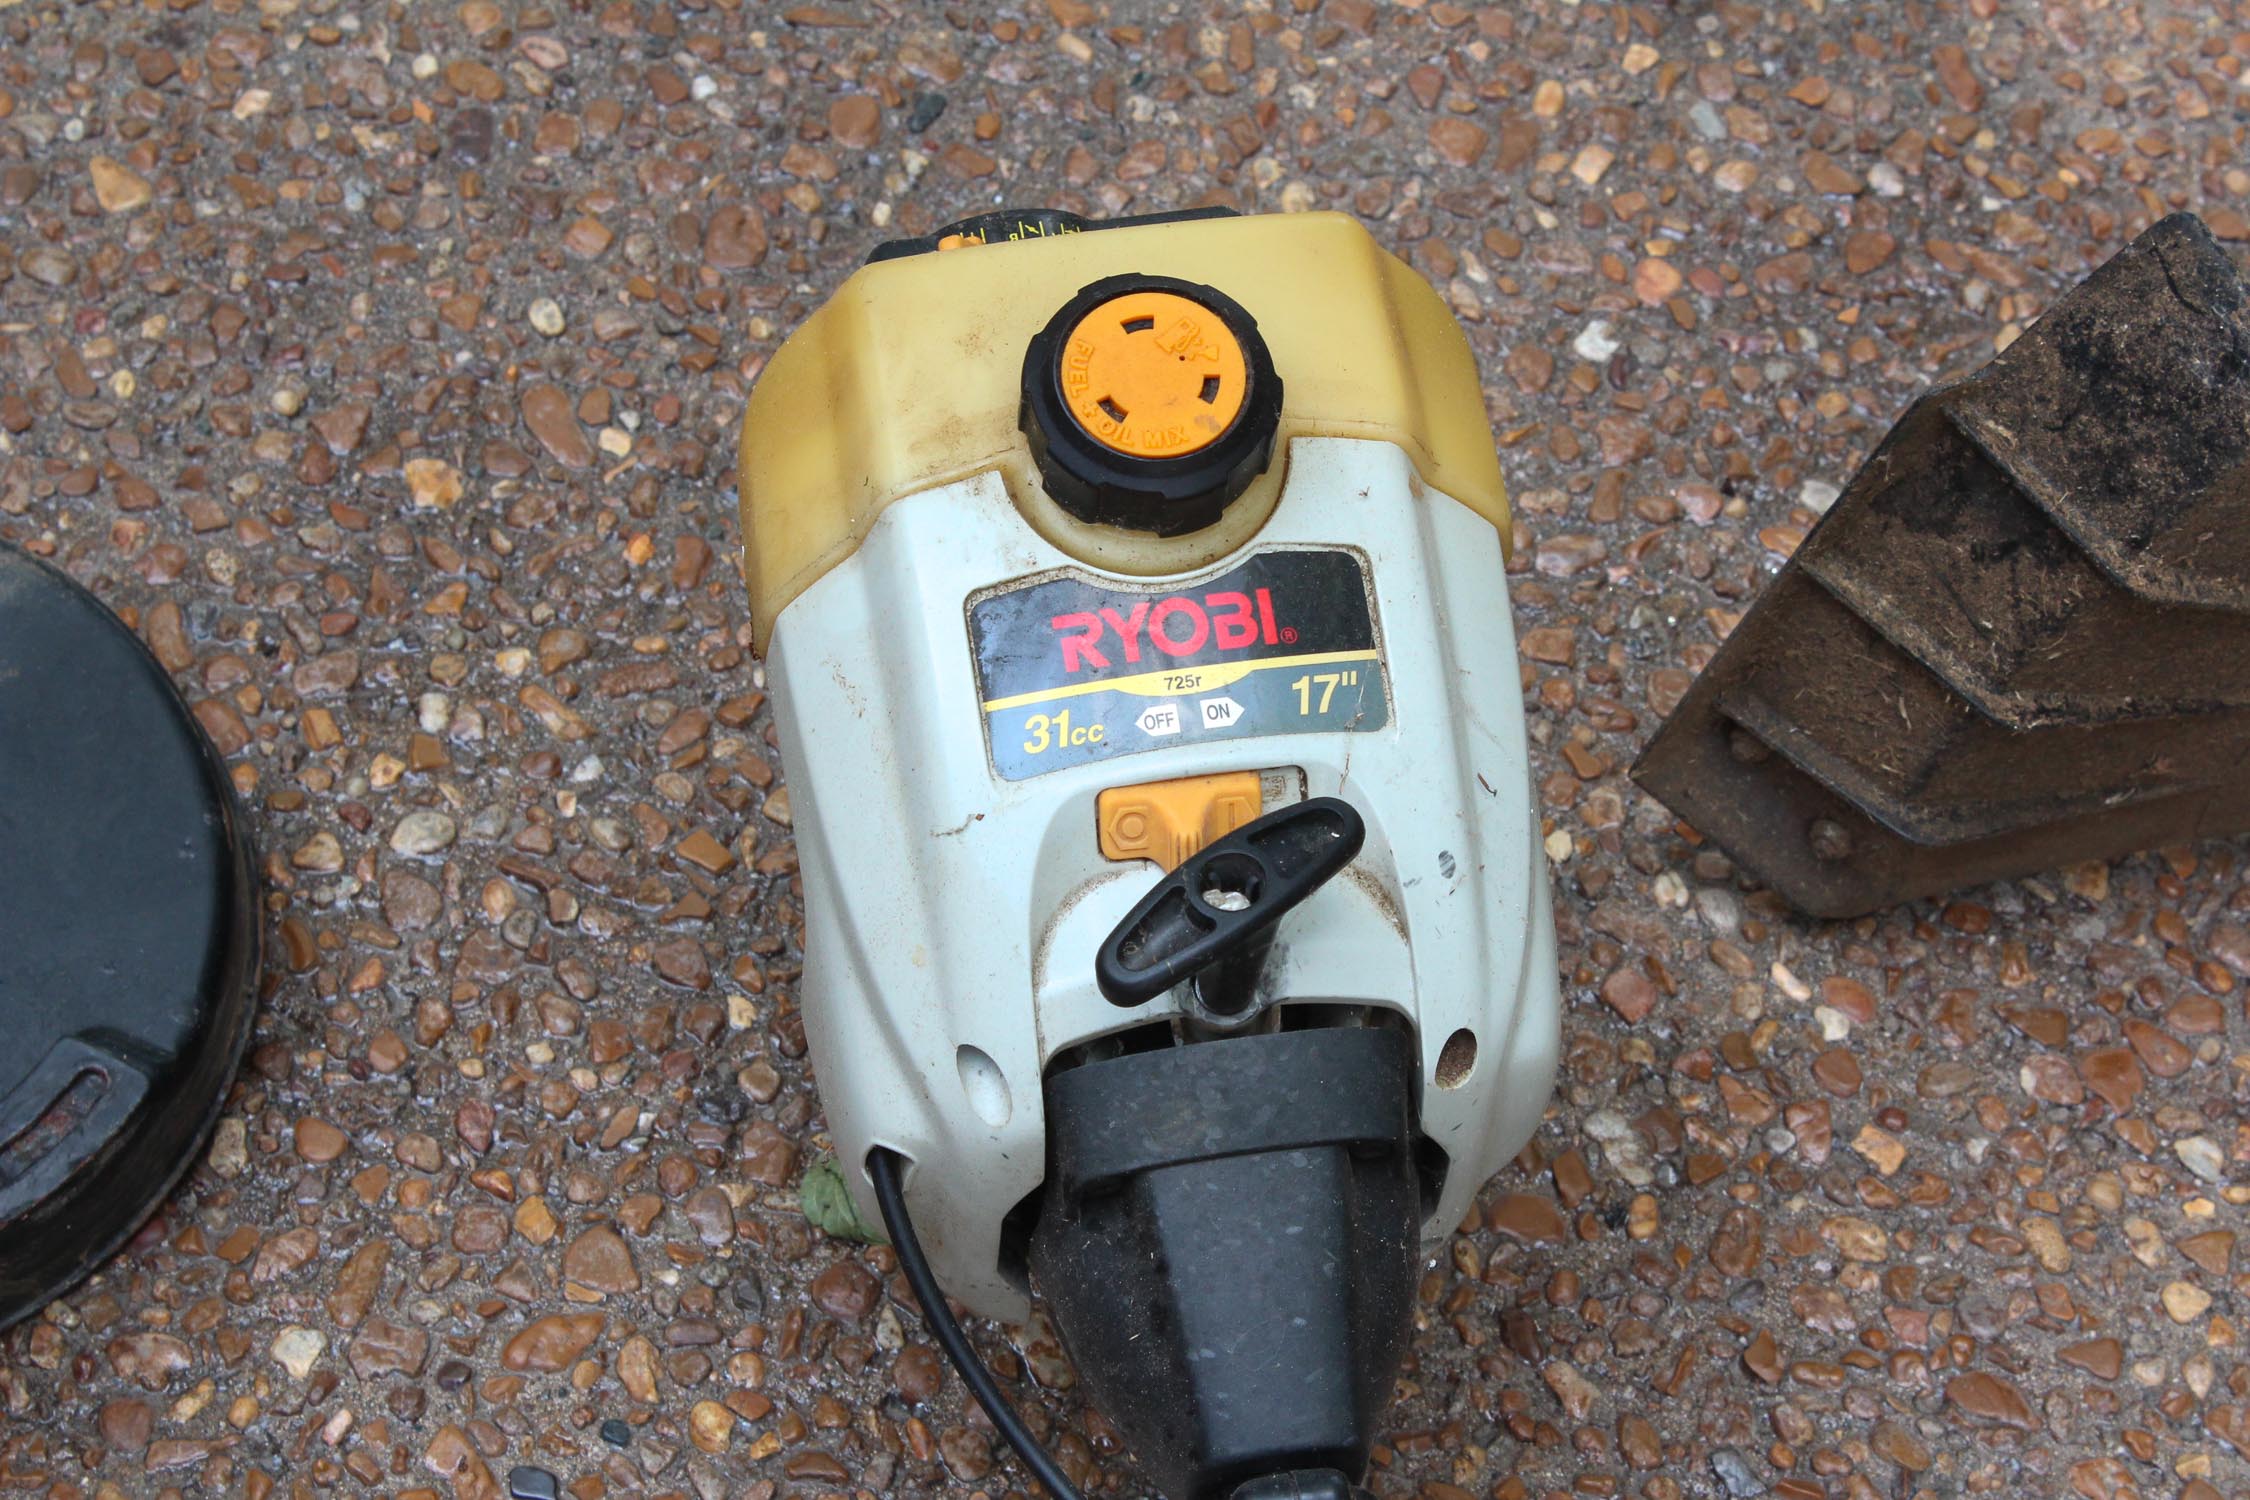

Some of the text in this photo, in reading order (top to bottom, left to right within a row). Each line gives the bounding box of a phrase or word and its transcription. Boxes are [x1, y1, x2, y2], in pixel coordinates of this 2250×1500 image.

[1070, 340, 1094, 399] FUEL
[1099, 422, 1134, 447] OIL
[1143, 427, 1189, 449] MIX
[1023, 670, 1357, 754] 31cc OFF ON 17"
[1164, 674, 1202, 690] 725r
